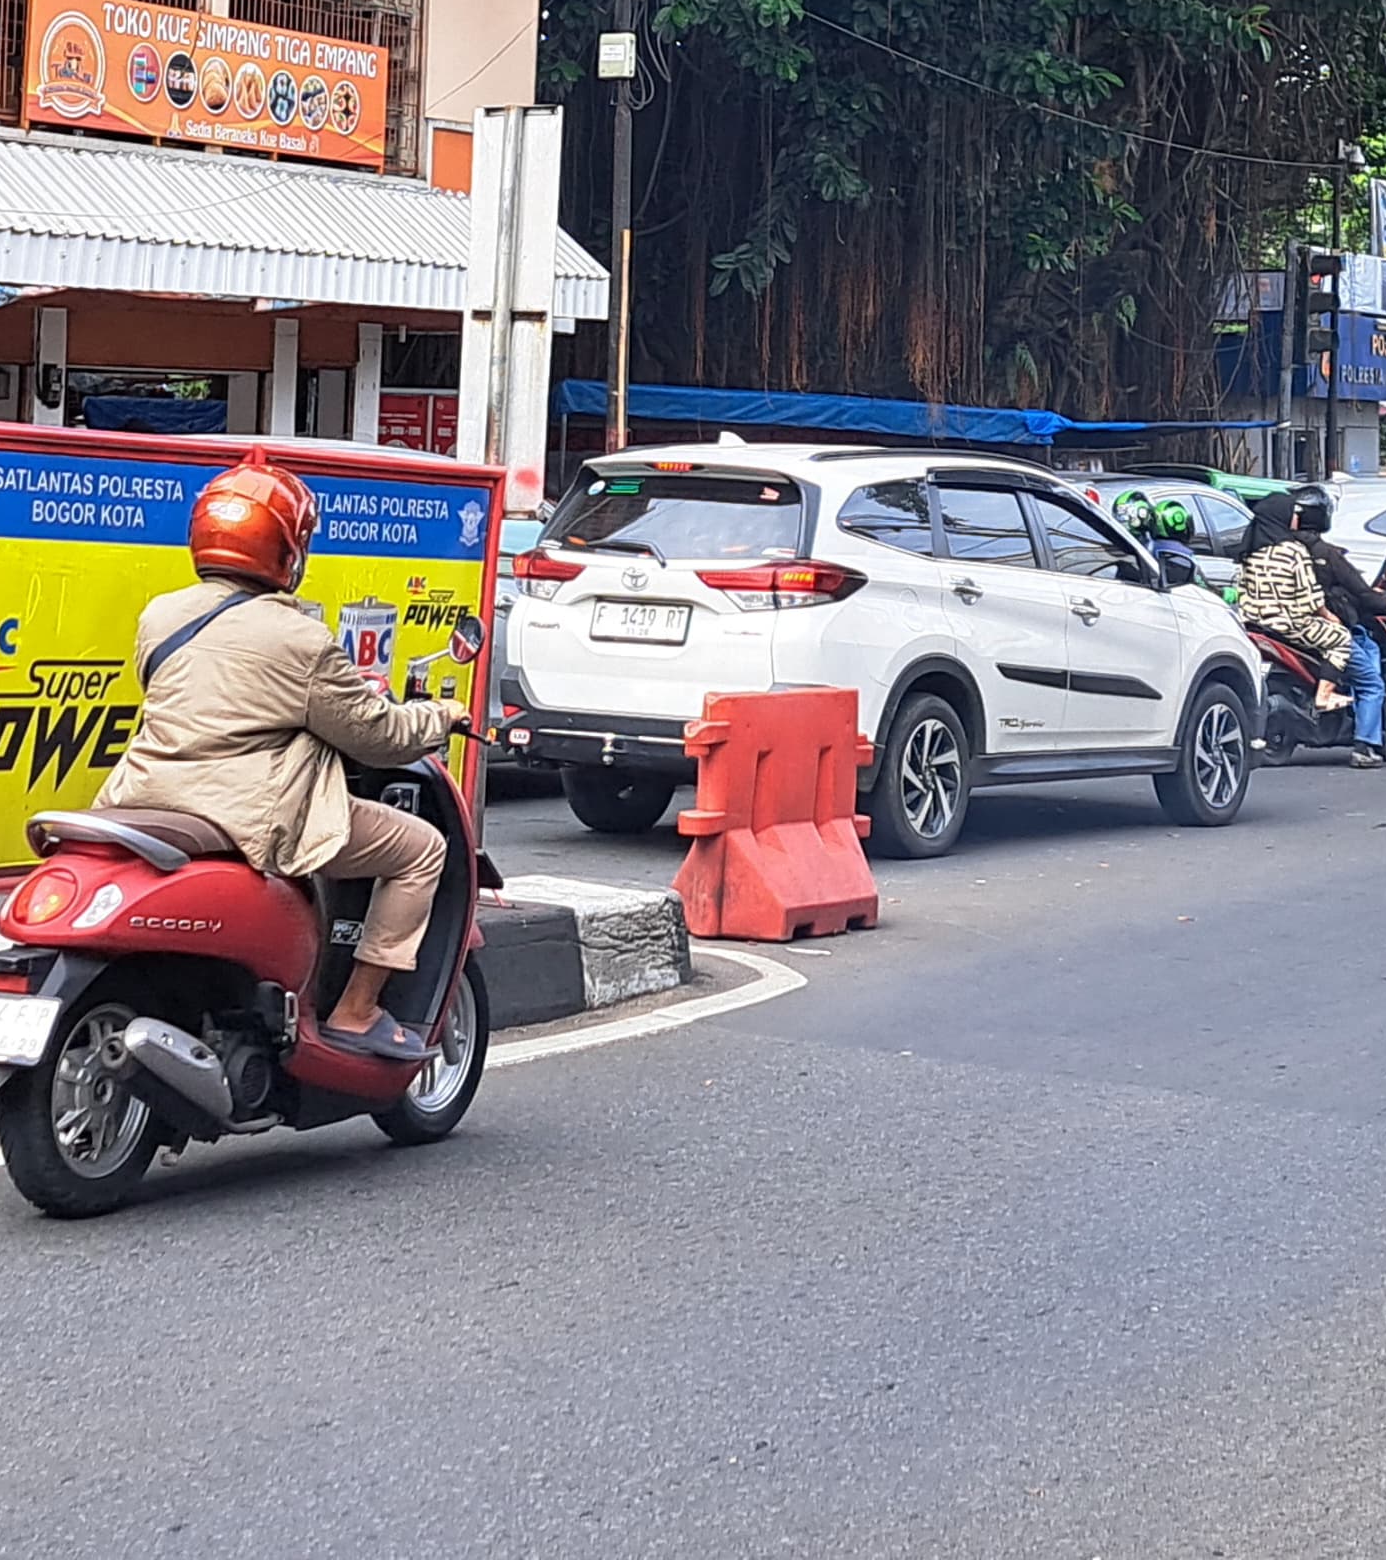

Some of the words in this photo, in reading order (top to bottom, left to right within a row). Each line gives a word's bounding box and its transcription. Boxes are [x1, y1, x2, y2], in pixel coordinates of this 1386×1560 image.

[102, 3, 151, 39] TOKO
[156, 12, 190, 46] KUE
[195, 20, 271, 59] SIMPANG
[274, 34, 311, 66] TIGA
[315, 44, 378, 79] EMPANG
[185, 120, 212, 138] Sedia
[1340, 364, 1384, 385] POLRESTA
[98, 475, 184, 502] POLRESTA
[31, 499, 95, 526] BOGOR
[100, 504, 145, 529] KOTA
[316, 492, 378, 514] TLANTAS
[380, 496, 449, 519] POLRESTA
[328, 520, 379, 541] BOGOR
[382, 524, 418, 544] KOTA
[406, 575, 427, 589] ABC
[596, 605, 608, 624] F
[621, 606, 657, 626] 1419
[665, 609, 685, 628] RT
[8, 659, 126, 707] Super
